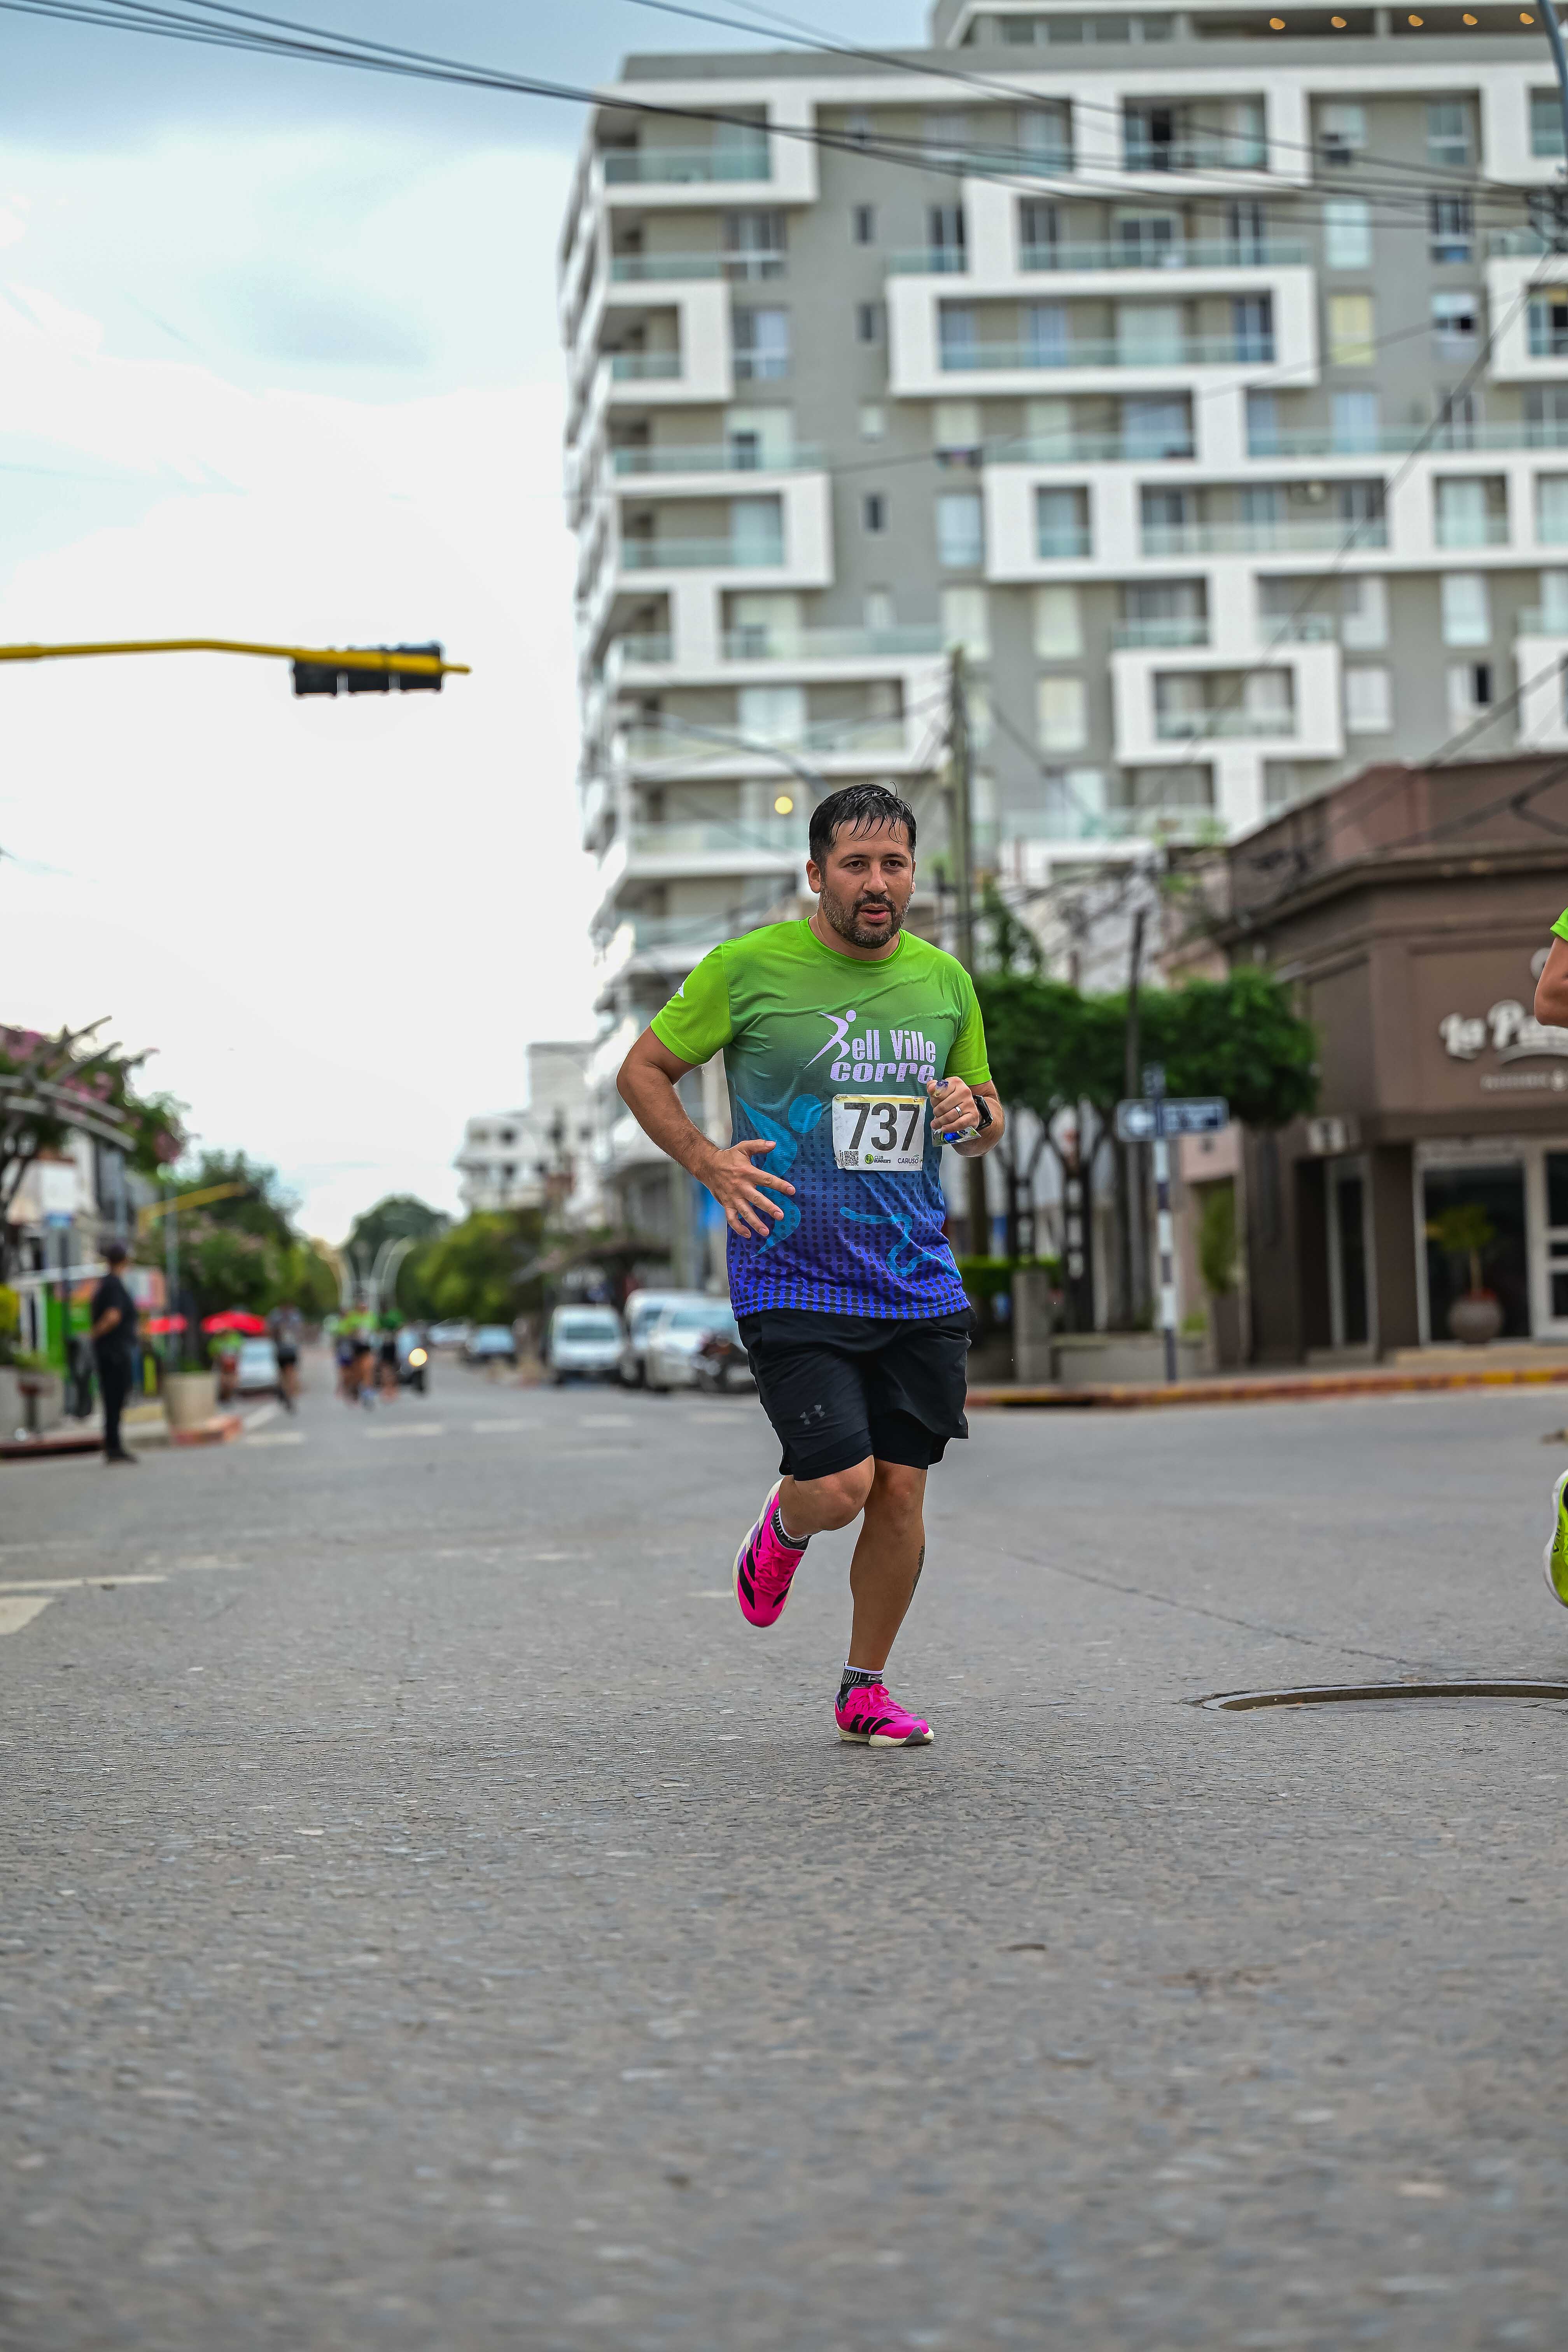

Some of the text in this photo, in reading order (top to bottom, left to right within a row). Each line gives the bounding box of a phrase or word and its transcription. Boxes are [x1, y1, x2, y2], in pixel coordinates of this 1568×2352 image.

[889, 1030, 936, 1063] Ville
[830, 1061, 936, 1084] corre
[844, 1102, 920, 1151] 737
